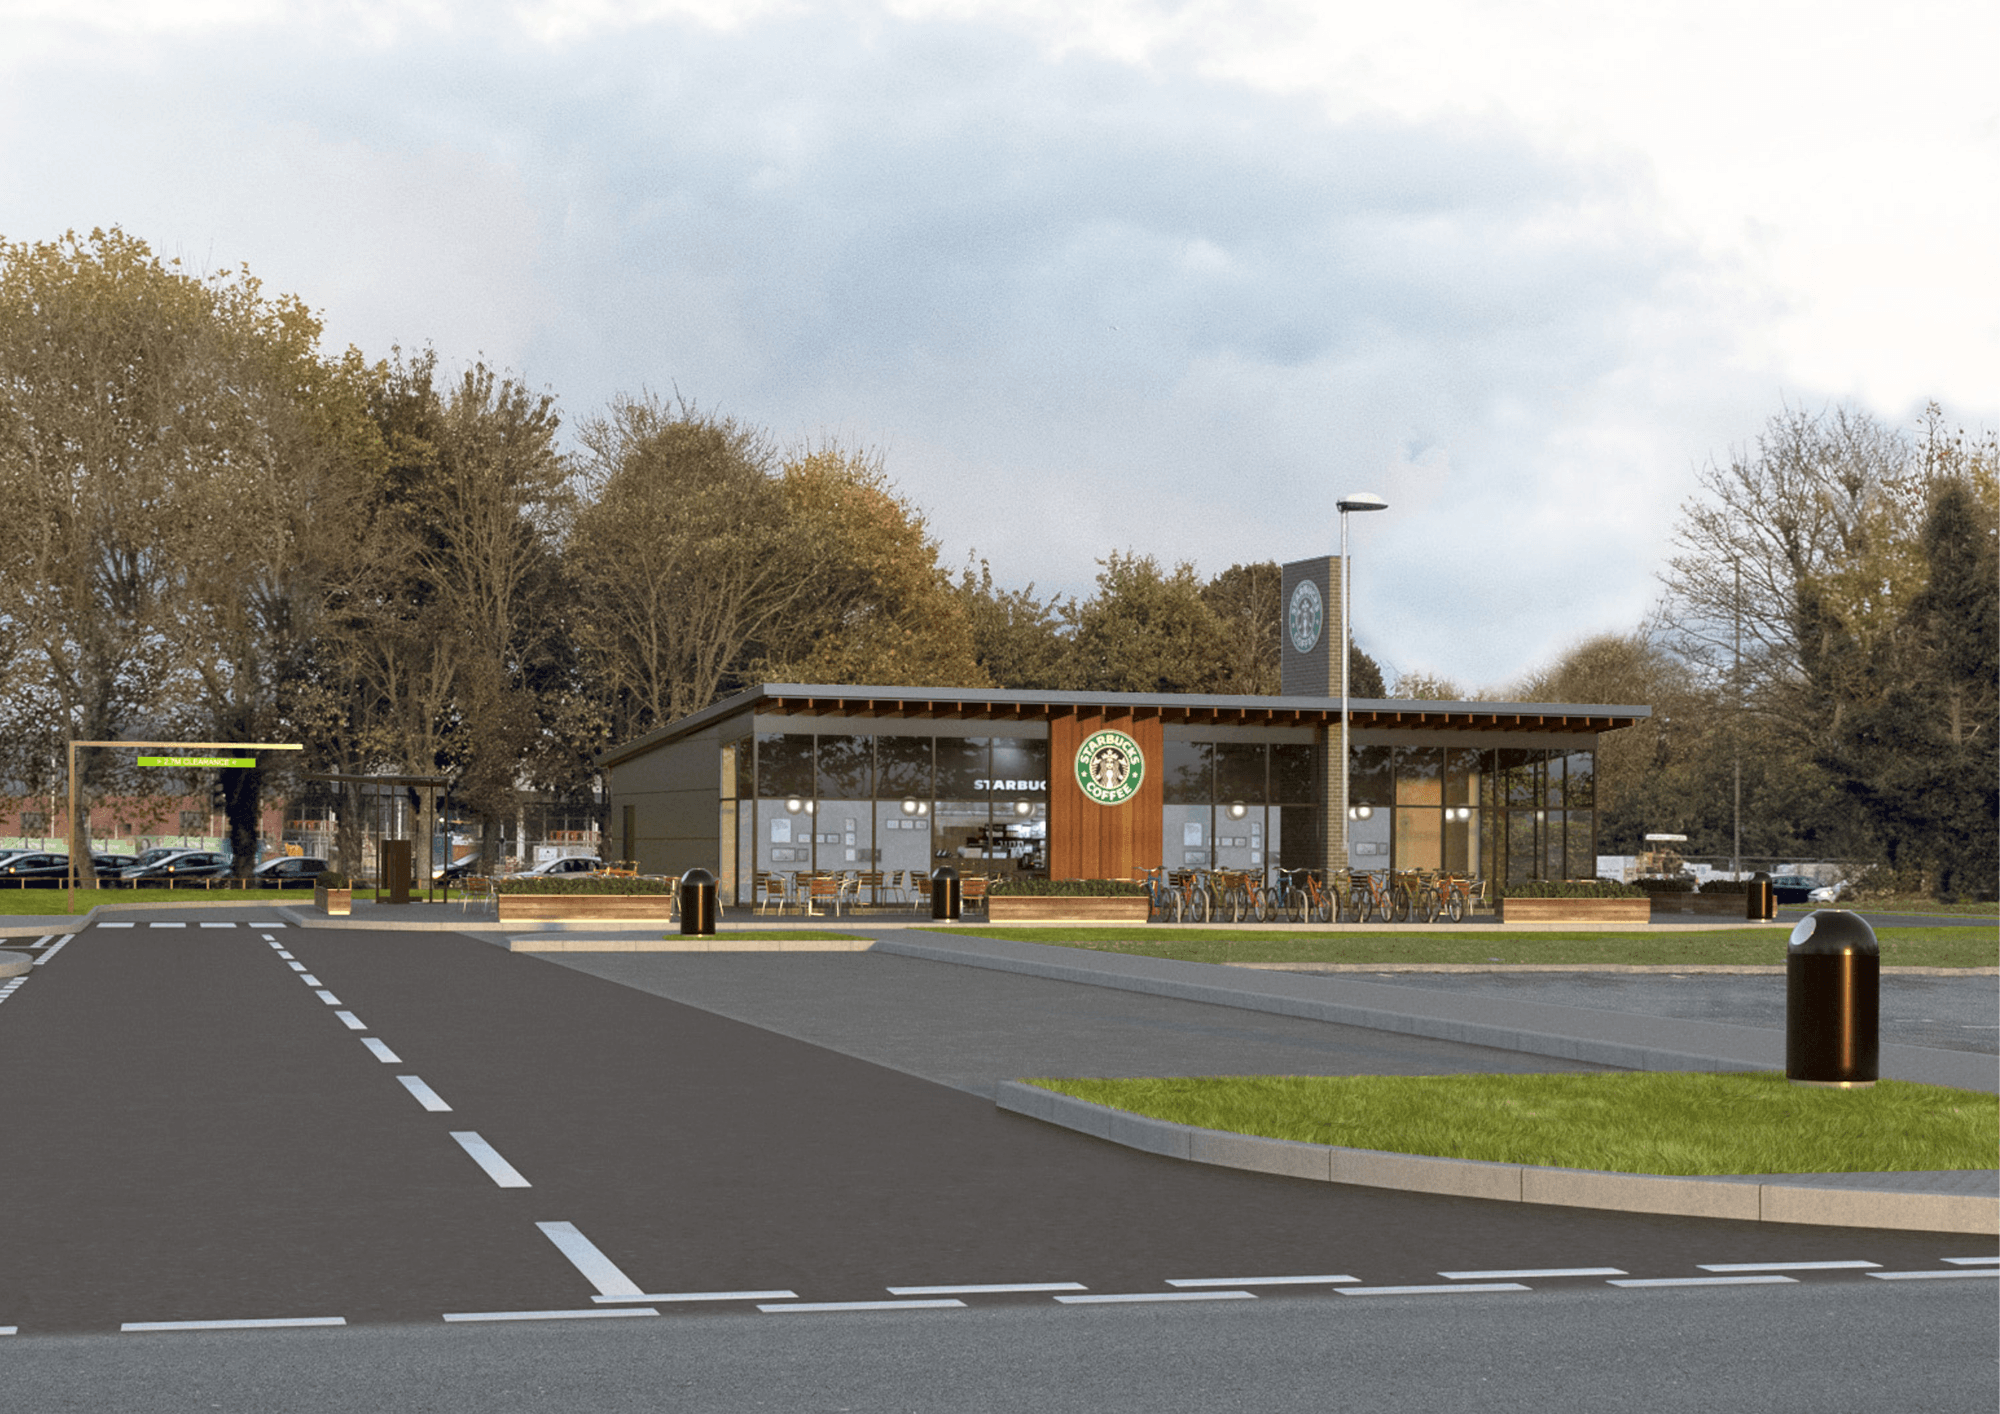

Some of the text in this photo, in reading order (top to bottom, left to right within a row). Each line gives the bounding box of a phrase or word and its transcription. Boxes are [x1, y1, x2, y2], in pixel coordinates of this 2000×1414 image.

[1080, 734, 1140, 766] STARBUCKS
[183, 758, 230, 766] CLEARANCE
[1086, 781, 1133, 801] COFFEE
